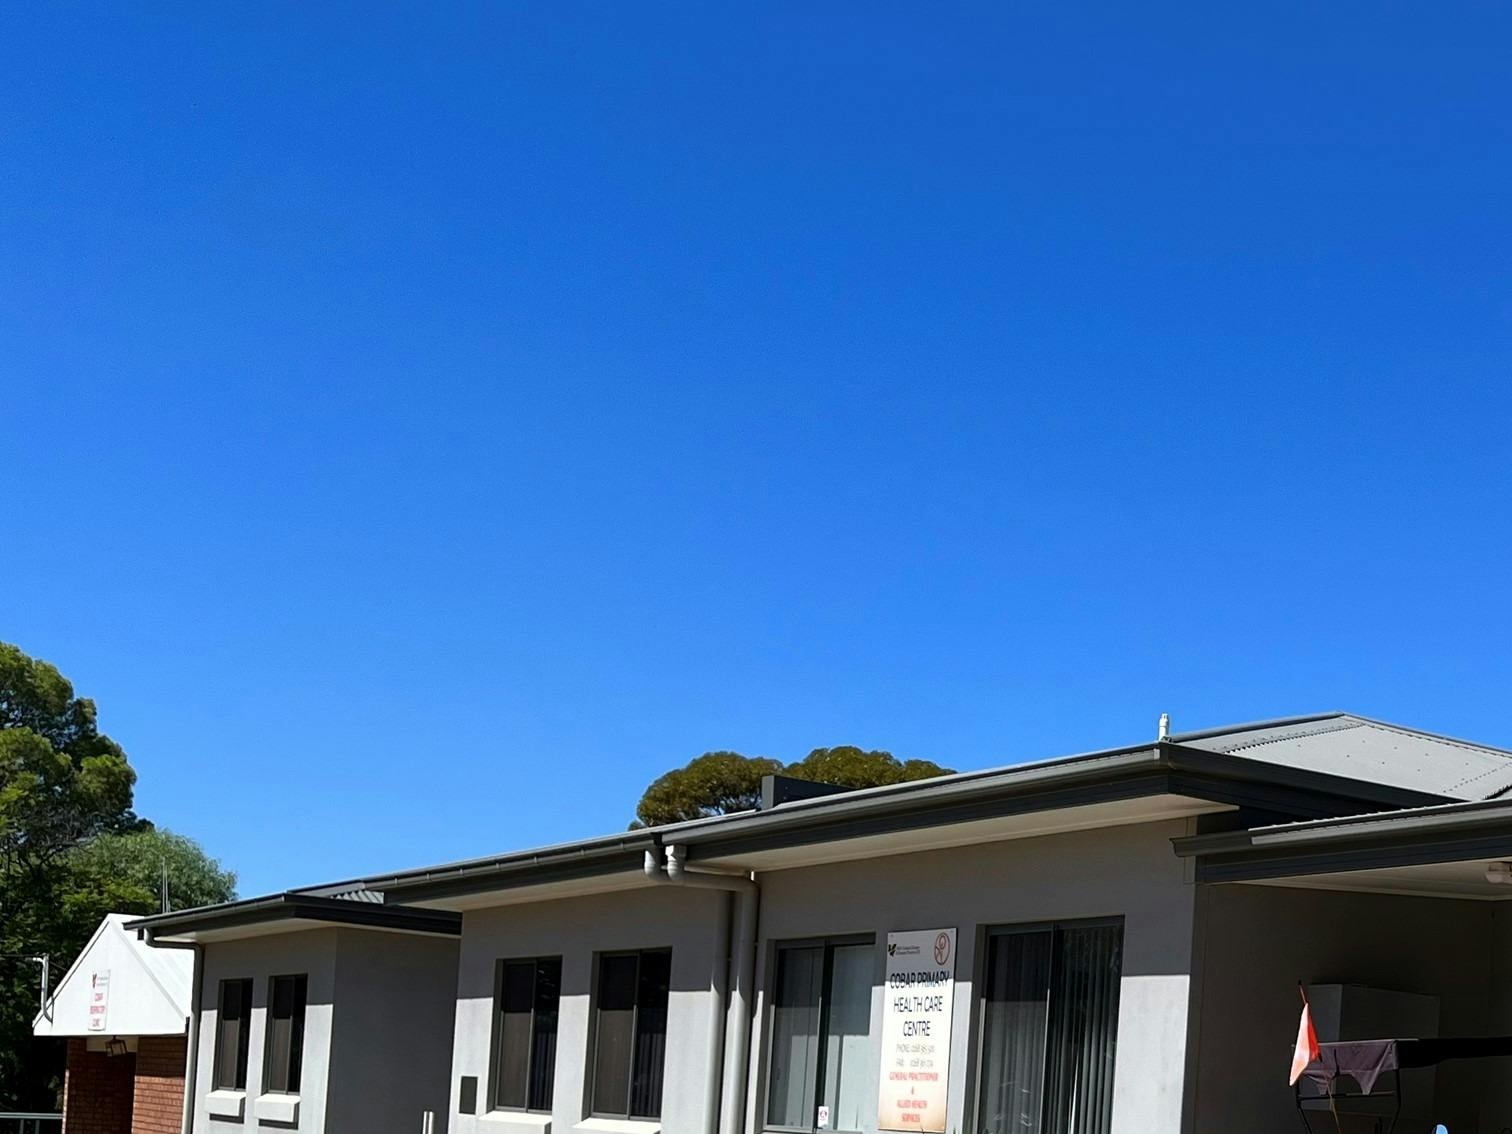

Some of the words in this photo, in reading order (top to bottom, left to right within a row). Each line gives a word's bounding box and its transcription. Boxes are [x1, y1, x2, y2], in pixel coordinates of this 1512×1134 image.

[890, 972, 916, 989] COBAR
[917, 970, 949, 988] PRIMARY
[894, 996, 923, 1012] HEALTH
[924, 995, 943, 1012] CARE
[903, 1020, 931, 1037] CENTRE
